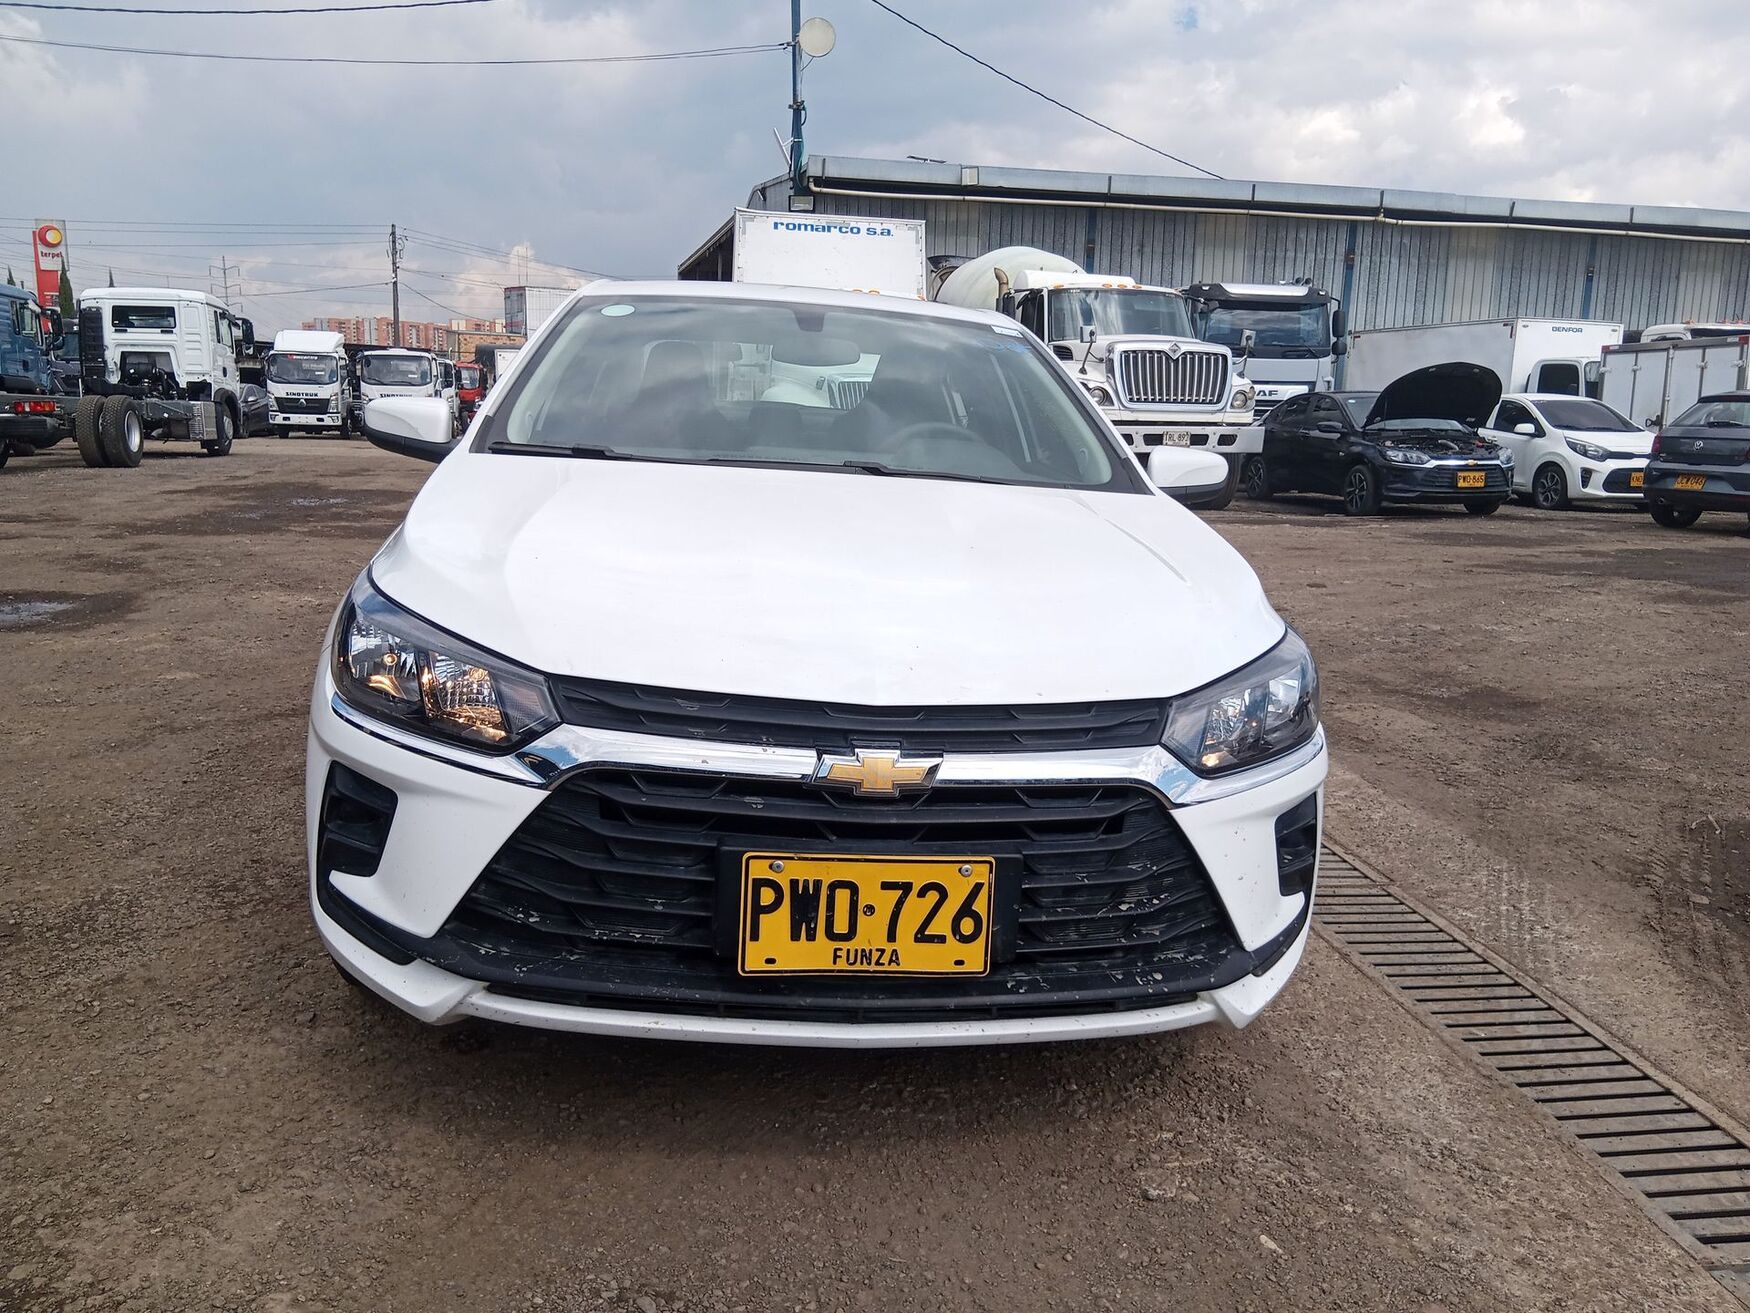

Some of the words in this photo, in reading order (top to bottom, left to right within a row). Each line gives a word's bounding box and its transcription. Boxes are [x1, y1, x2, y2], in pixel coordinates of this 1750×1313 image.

[773, 221, 861, 235] romarco
[865, 227, 894, 237] s.a.
[40, 250, 63, 259] terpel
[832, 946, 901, 967] FUNZA
